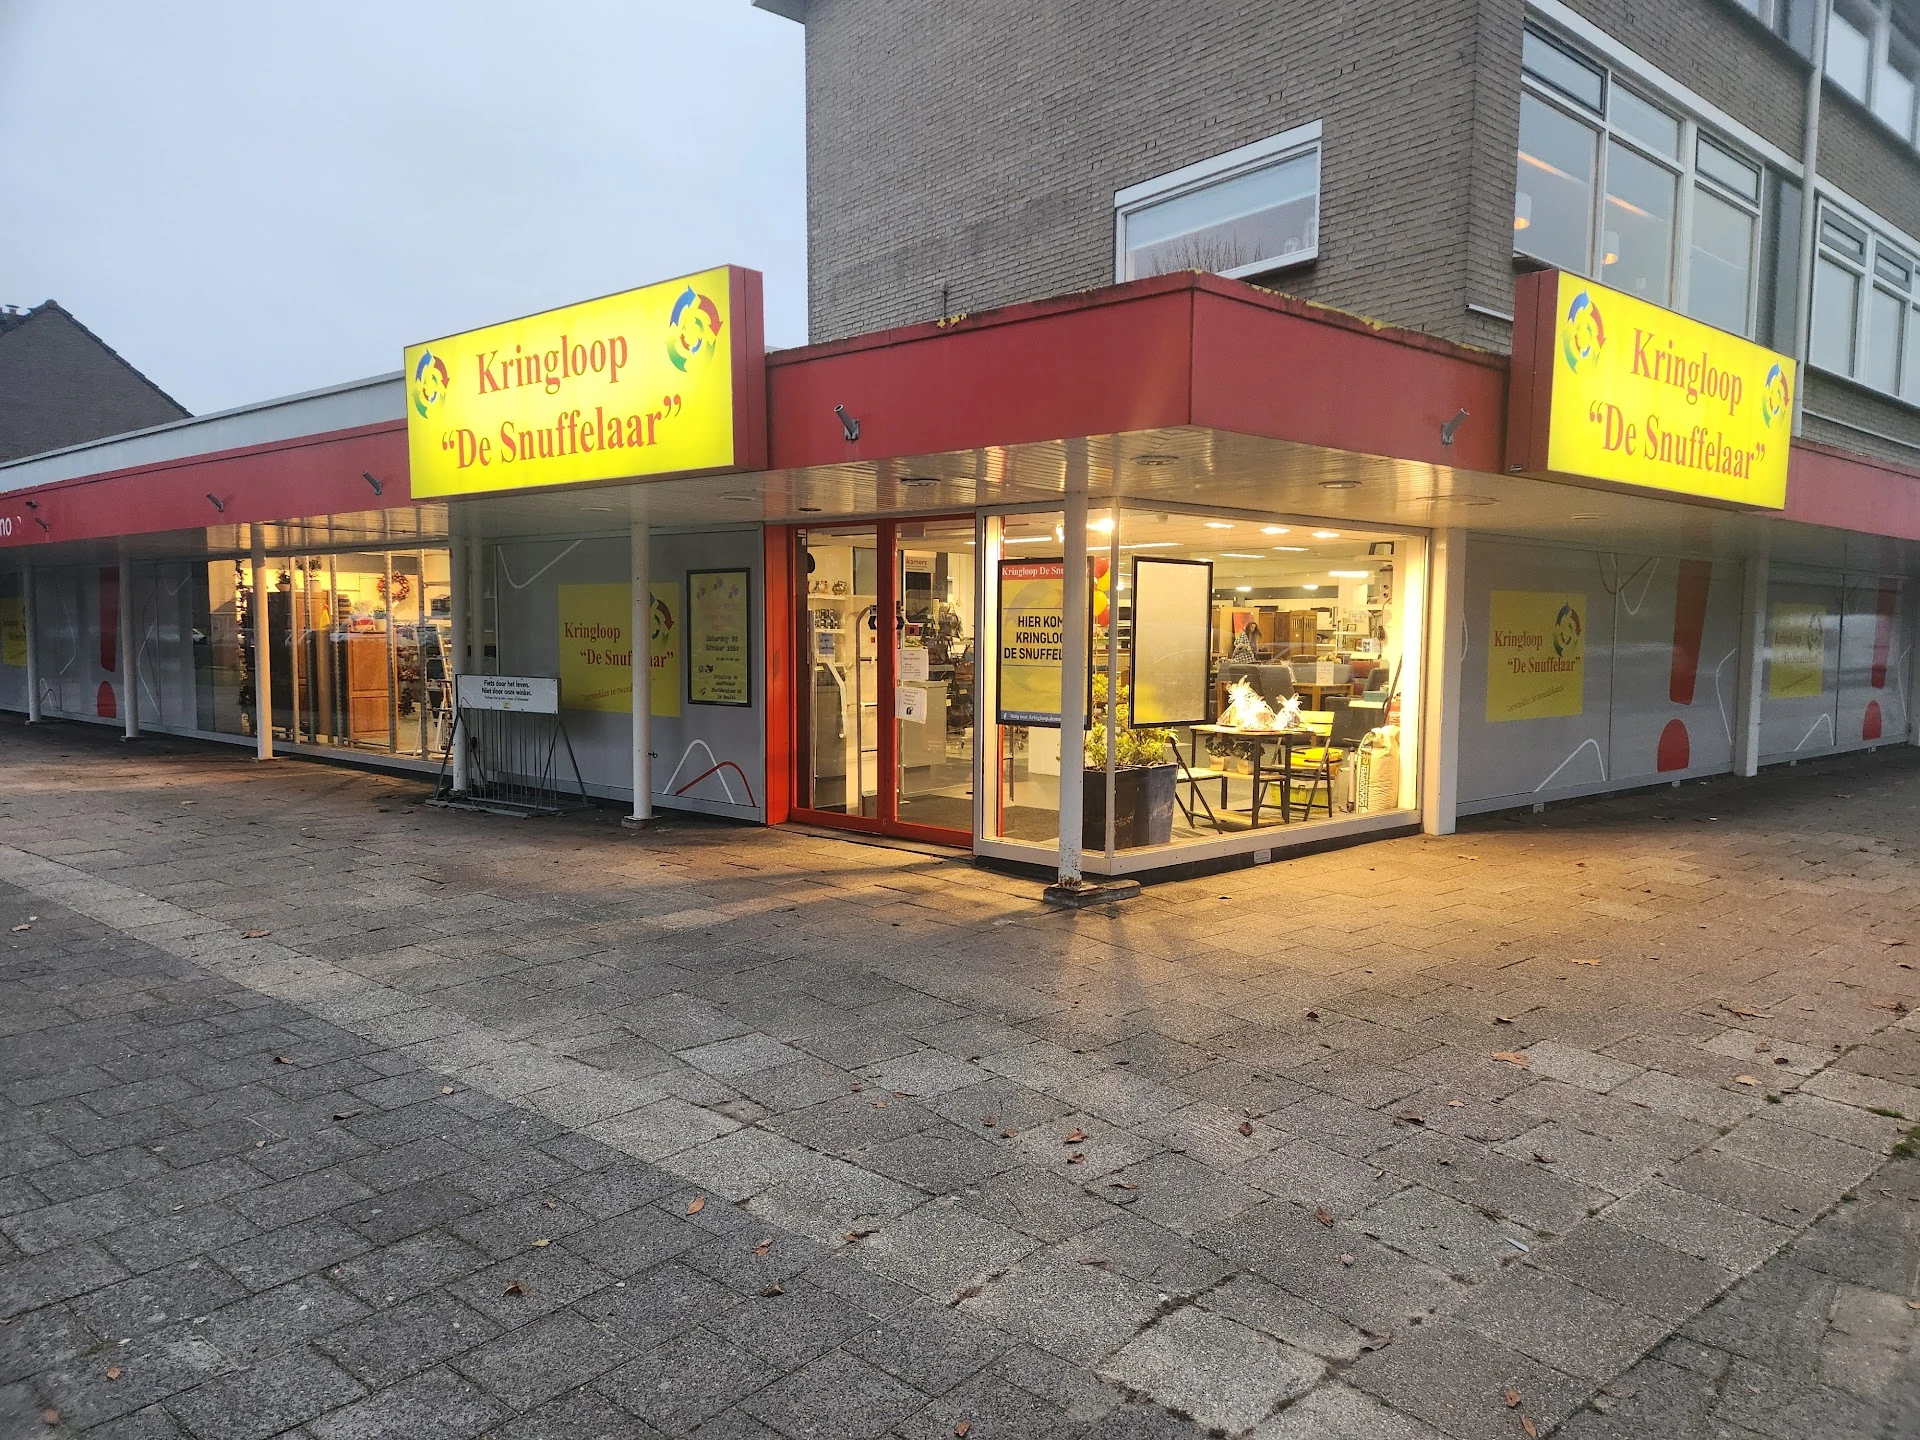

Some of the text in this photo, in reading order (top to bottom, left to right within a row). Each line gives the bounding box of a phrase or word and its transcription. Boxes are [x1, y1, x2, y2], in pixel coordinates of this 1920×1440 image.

[476, 335, 628, 395] Kringloop
[1630, 327, 1743, 416] Kringloop
[442, 394, 682, 469] “De Snuffelaar”
[1589, 399, 1766, 480] “De Snuffelaar”
[1002, 567, 1038, 577] Kringloop
[1040, 566, 1050, 575] De
[1017, 615, 1041, 627] HIER
[564, 622, 621, 643] Kringloop
[1016, 632, 1063, 643] KRINGLO
[1494, 630, 1543, 651] Kringloop
[1004, 647, 1063, 660] DE SNUFFEL
